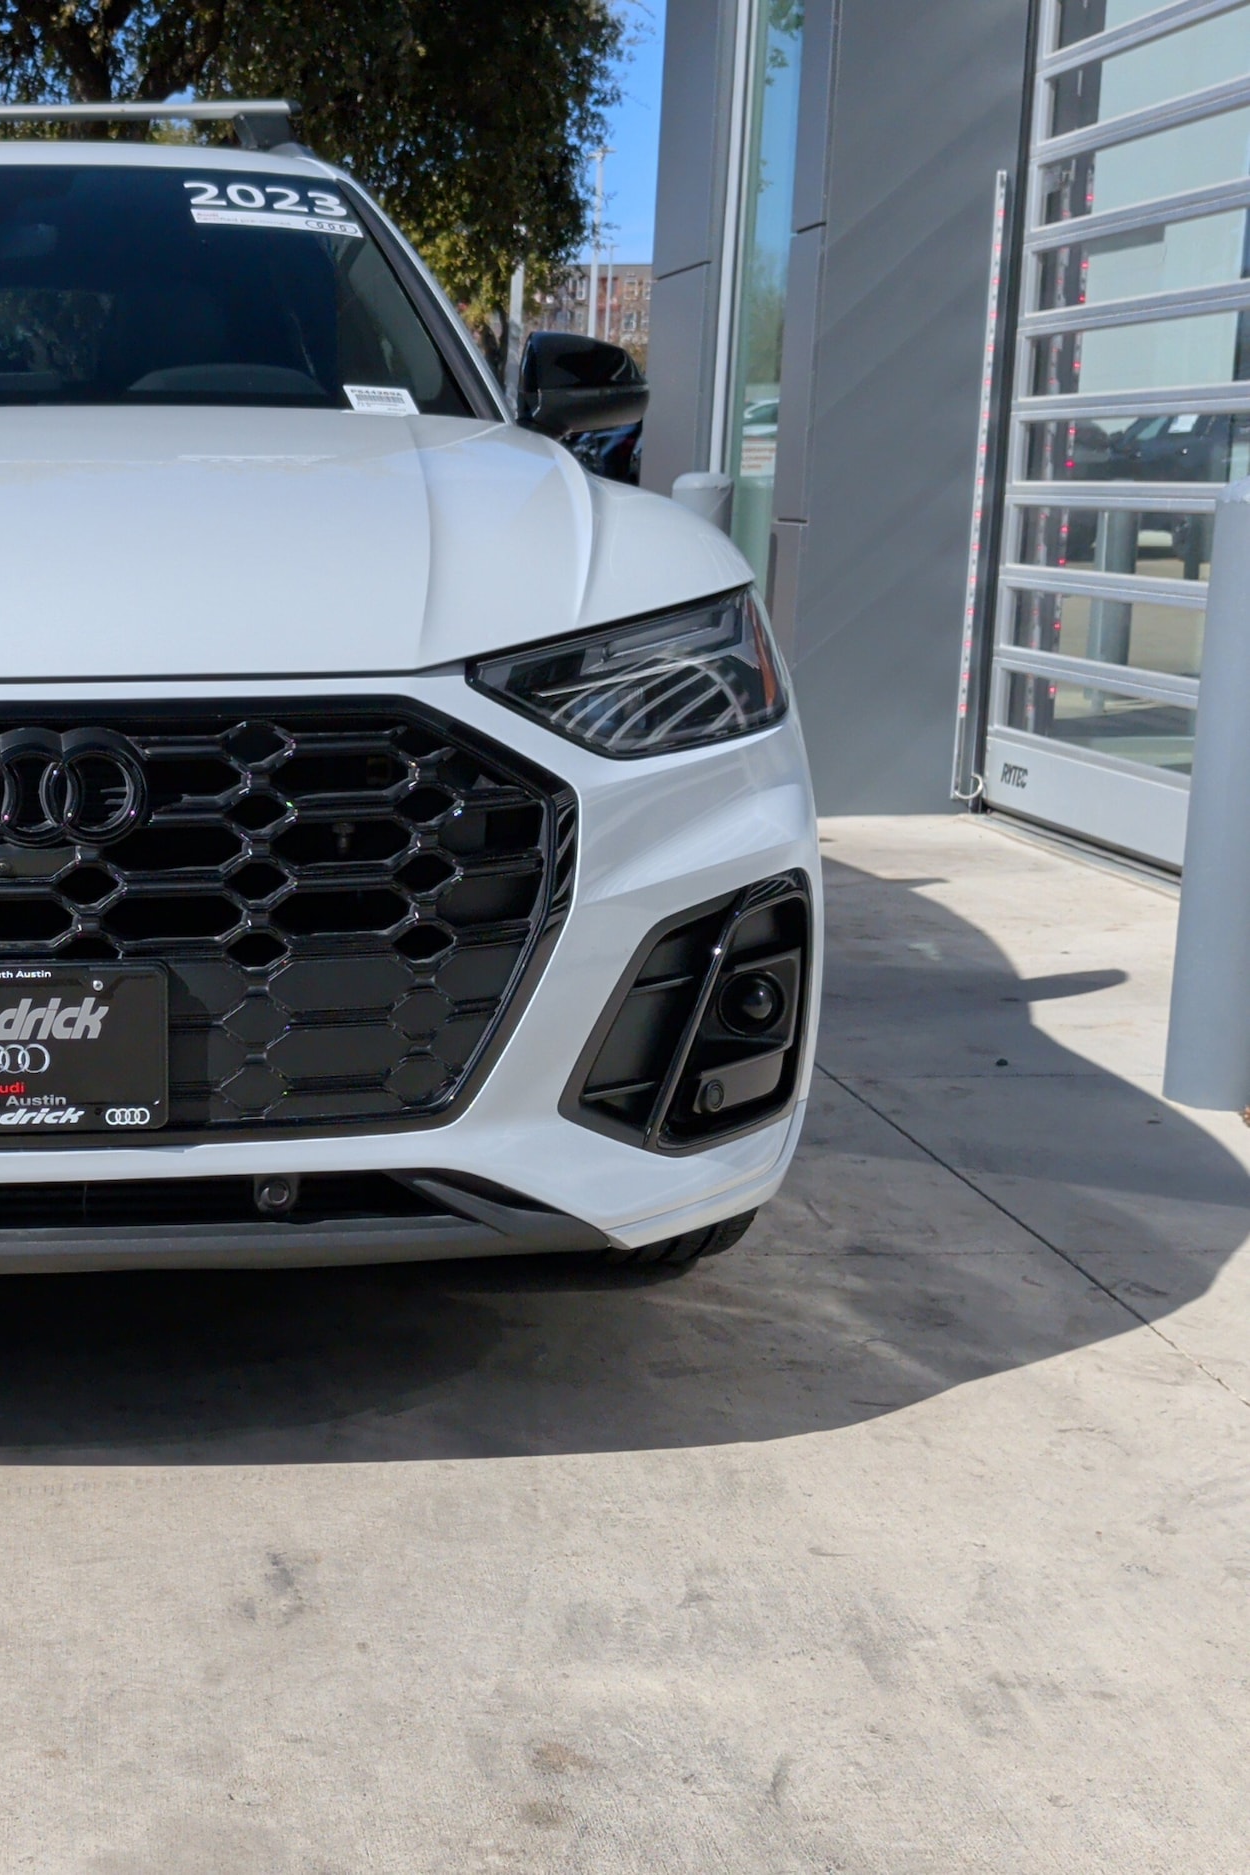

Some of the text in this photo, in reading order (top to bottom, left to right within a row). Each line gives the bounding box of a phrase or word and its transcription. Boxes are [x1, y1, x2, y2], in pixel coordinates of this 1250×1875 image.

[183, 181, 348, 217] 2023
[1000, 762, 1029, 789] RYTEC
[15, 969, 52, 980] Austin
[5, 1094, 67, 1107] Austin
